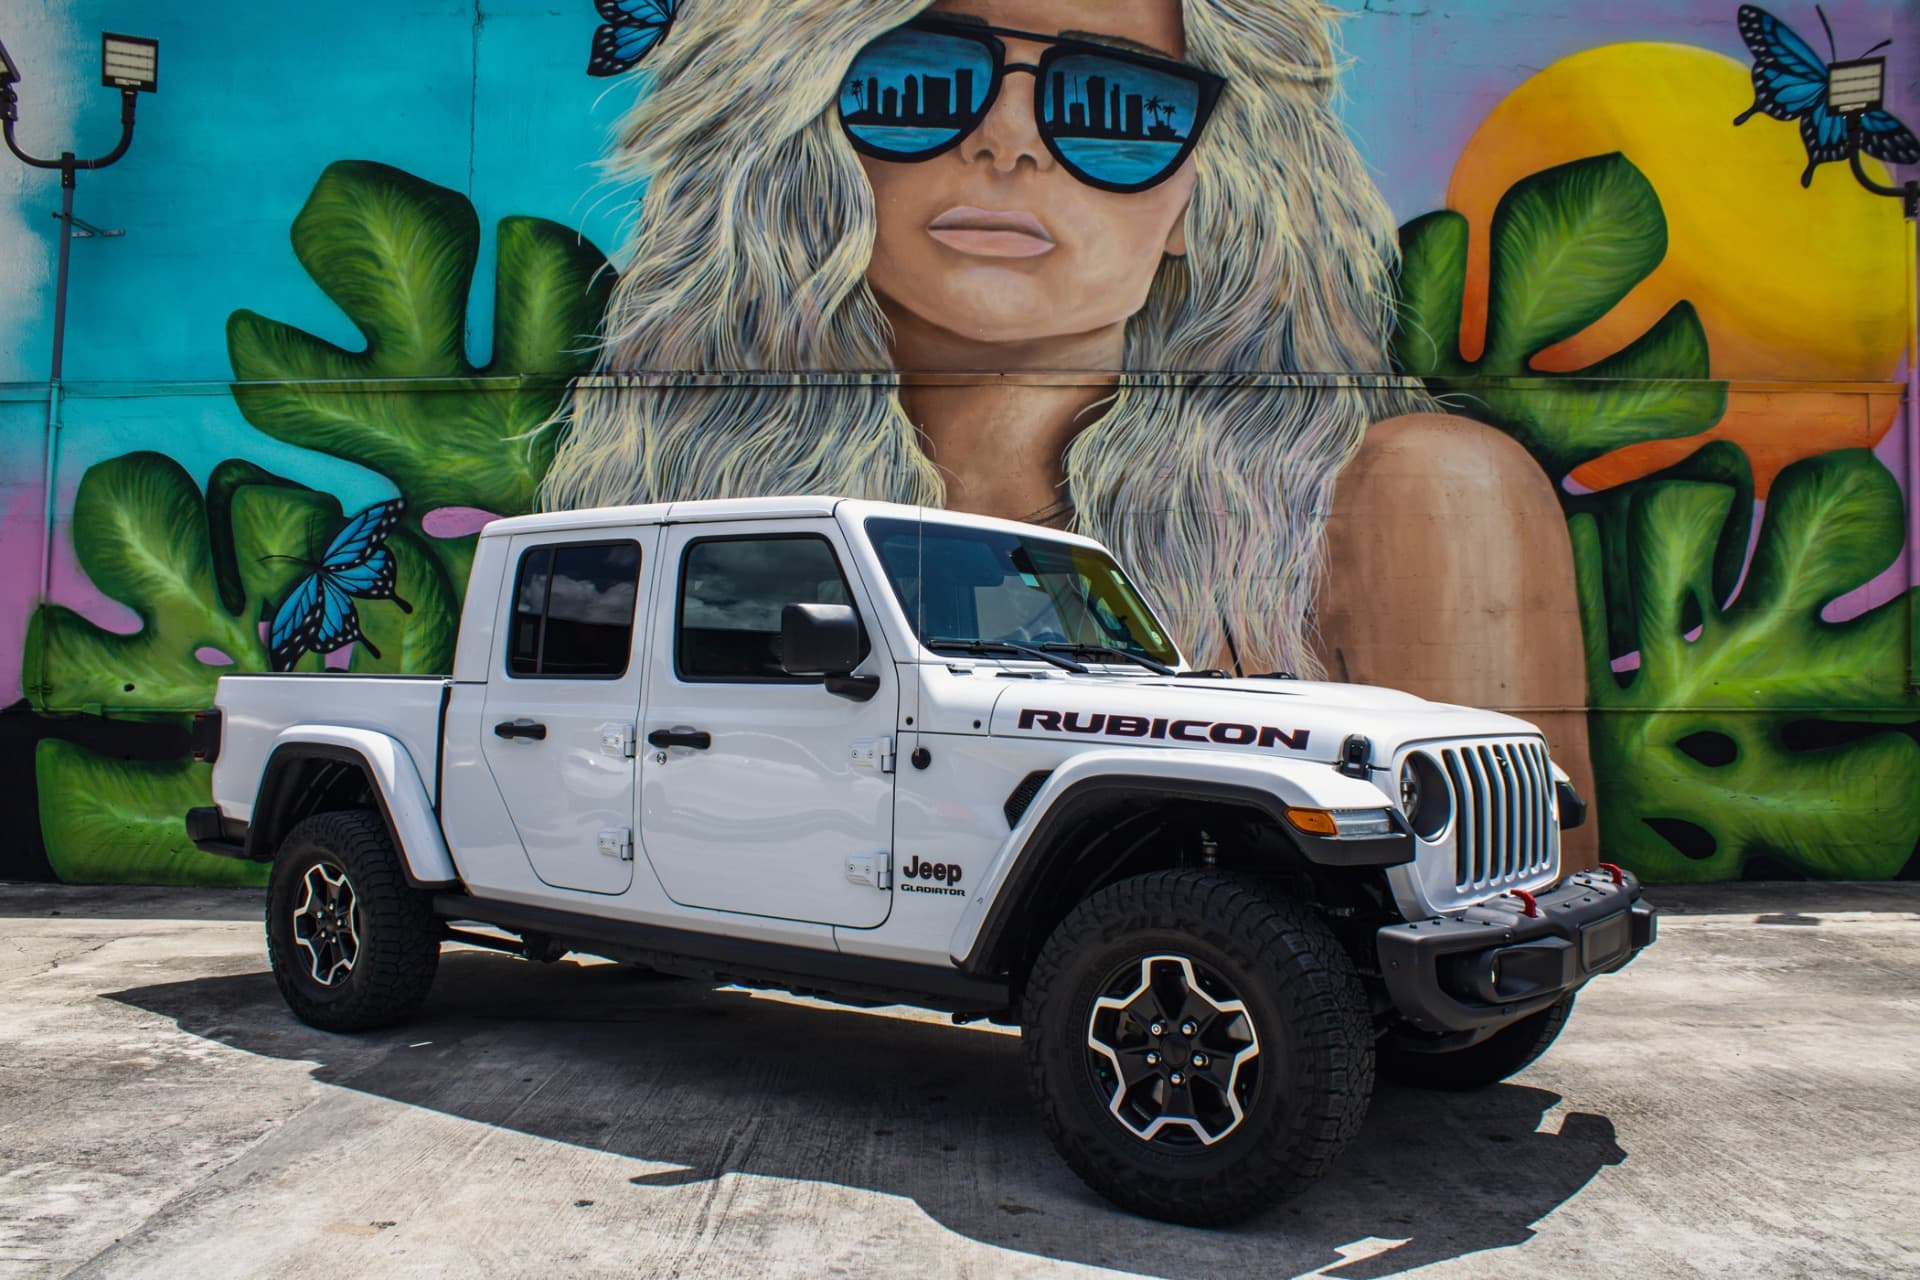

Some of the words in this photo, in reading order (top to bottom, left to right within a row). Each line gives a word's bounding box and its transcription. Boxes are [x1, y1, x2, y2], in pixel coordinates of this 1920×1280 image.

[1017, 708, 1311, 751] RUBICON
[903, 855, 962, 886] Jeep
[901, 883, 966, 896] GLADIATOR
